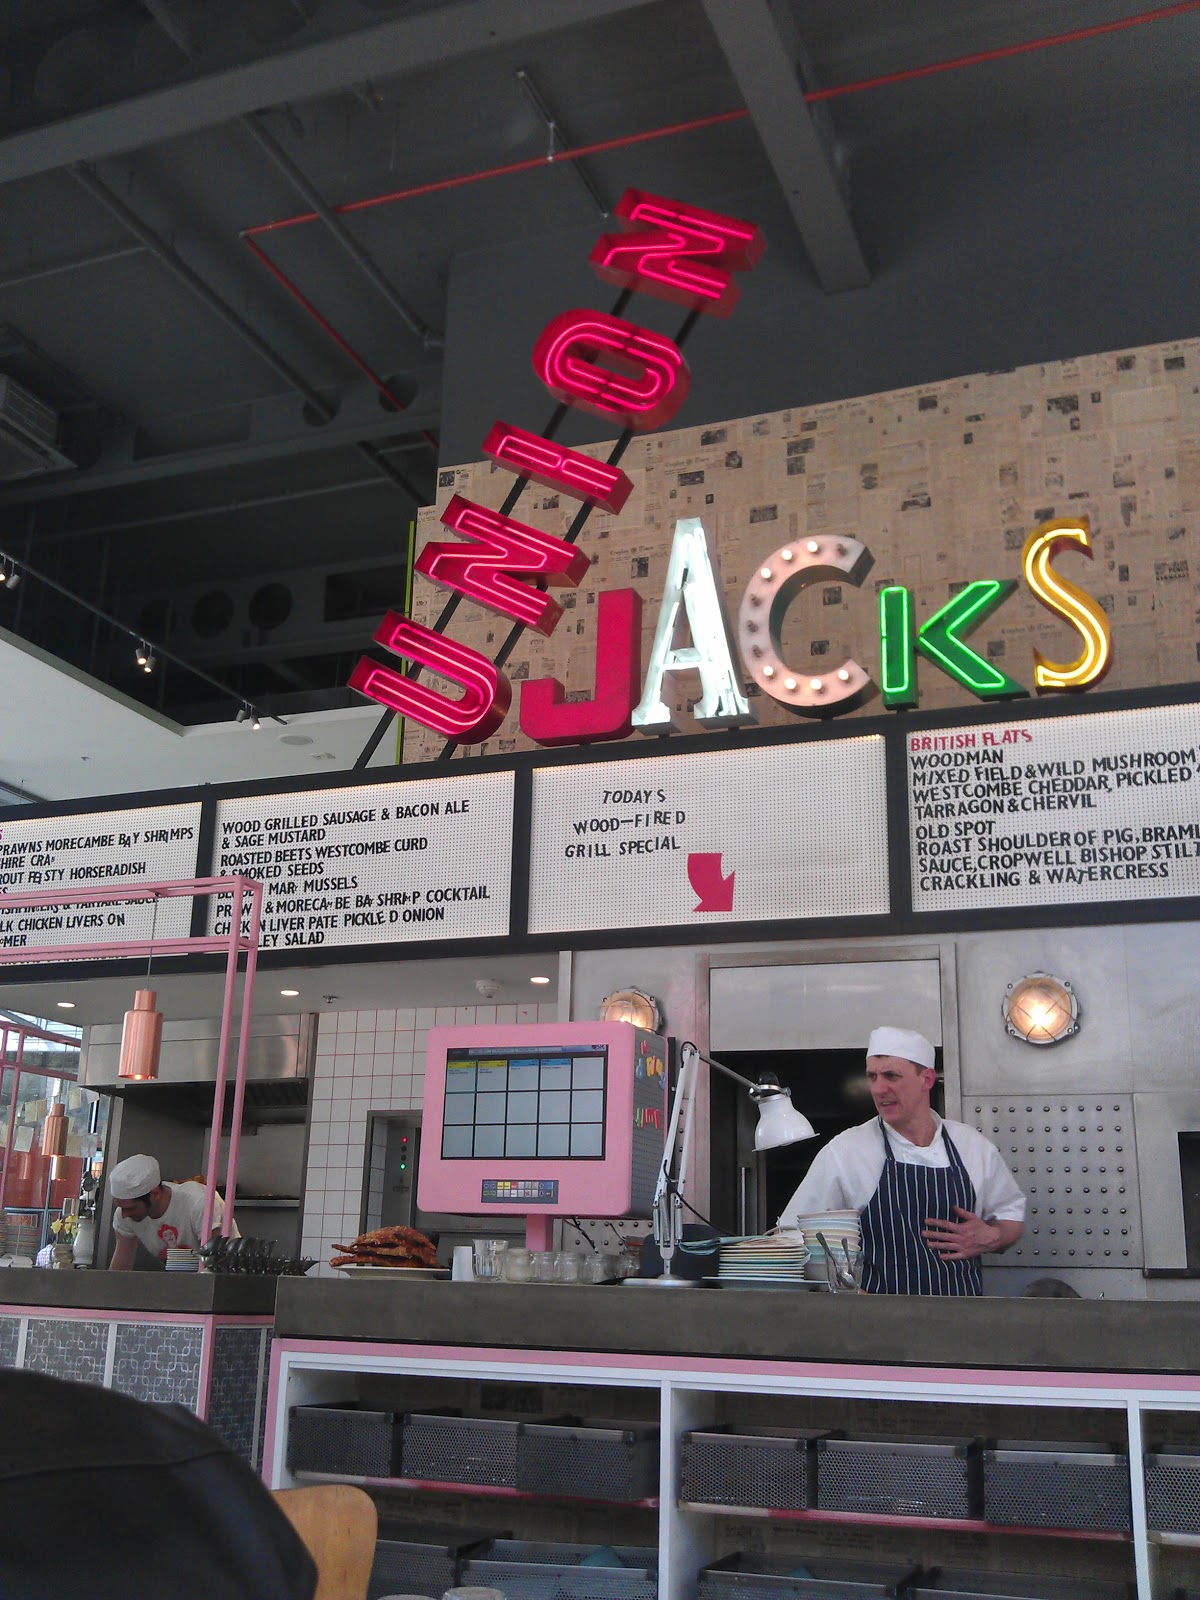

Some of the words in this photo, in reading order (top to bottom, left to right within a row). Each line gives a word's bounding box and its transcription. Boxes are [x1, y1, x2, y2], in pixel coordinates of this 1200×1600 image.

[347, 188, 766, 745] UNION
[518, 515, 1112, 746] JACKS
[910, 734, 976, 751] BRITISH
[982, 729, 1033, 746] FLATS
[911, 749, 1004, 770] WOODMAN
[913, 768, 970, 787] MIXED
[1092, 748, 1196, 772] MUSHROOM
[913, 783, 1022, 804] WESTCOMBE
[1028, 774, 1112, 795] CHEDDAR,
[1116, 767, 1192, 788] PICKLED
[223, 820, 261, 835] WOOD
[265, 815, 318, 831] GRILLED
[323, 809, 376, 826] SAUSAGE
[381, 808, 390, 820] &
[396, 802, 440, 819] BACON
[444, 800, 470, 814] ALE
[915, 824, 949, 840] OLD
[954, 820, 996, 837] SPOT
[46, 834, 115, 852] MORECAMBE
[118, 832, 140, 848] BAY
[144, 827, 193, 843] SHRIMPS
[222, 837, 231, 849] &
[235, 833, 264, 848] SAGE
[268, 828, 326, 845] MUSTARD
[565, 843, 611, 858] GRILL
[619, 836, 681, 856] SPECIAL
[917, 838, 972, 857] ROAST
[978, 831, 1071, 852] SHOULDER
[1074, 830, 1097, 846] OF
[1142, 823, 1200, 842] BRAML
[0, 856, 25, 870] HIRE
[221, 850, 272, 867] ROASTED
[275, 847, 312, 862] BEETS
[315, 840, 391, 859] WESTCOMBE
[394, 837, 428, 851] CURD
[977, 851, 1076, 871] CROPWELL
[1080, 845, 1147, 864] BISHOP
[1151, 841, 1200, 860] STILT
[0, 872, 24, 885] ROUT
[70, 862, 147, 880] HORSERADISH
[287, 862, 324, 877] SEEDS
[920, 871, 1020, 891] CRACKLING
[1028, 870, 1041, 885] &
[1046, 862, 1169, 885] WATERCRESS
[304, 876, 358, 893] MUSSELS
[265, 901, 274, 914] &
[426, 885, 490, 903] COCKTAIL
[0, 920, 13, 932] LK
[18, 917, 63, 931] CHICKEN
[66, 914, 103, 928] LIVERS
[107, 913, 125, 926] ON
[214, 920, 266, 934] CHKN
[270, 917, 305, 931] LIVER
[308, 915, 338, 929] PATE
[402, 907, 445, 922] ONION
[285, 931, 325, 946] SALAD
